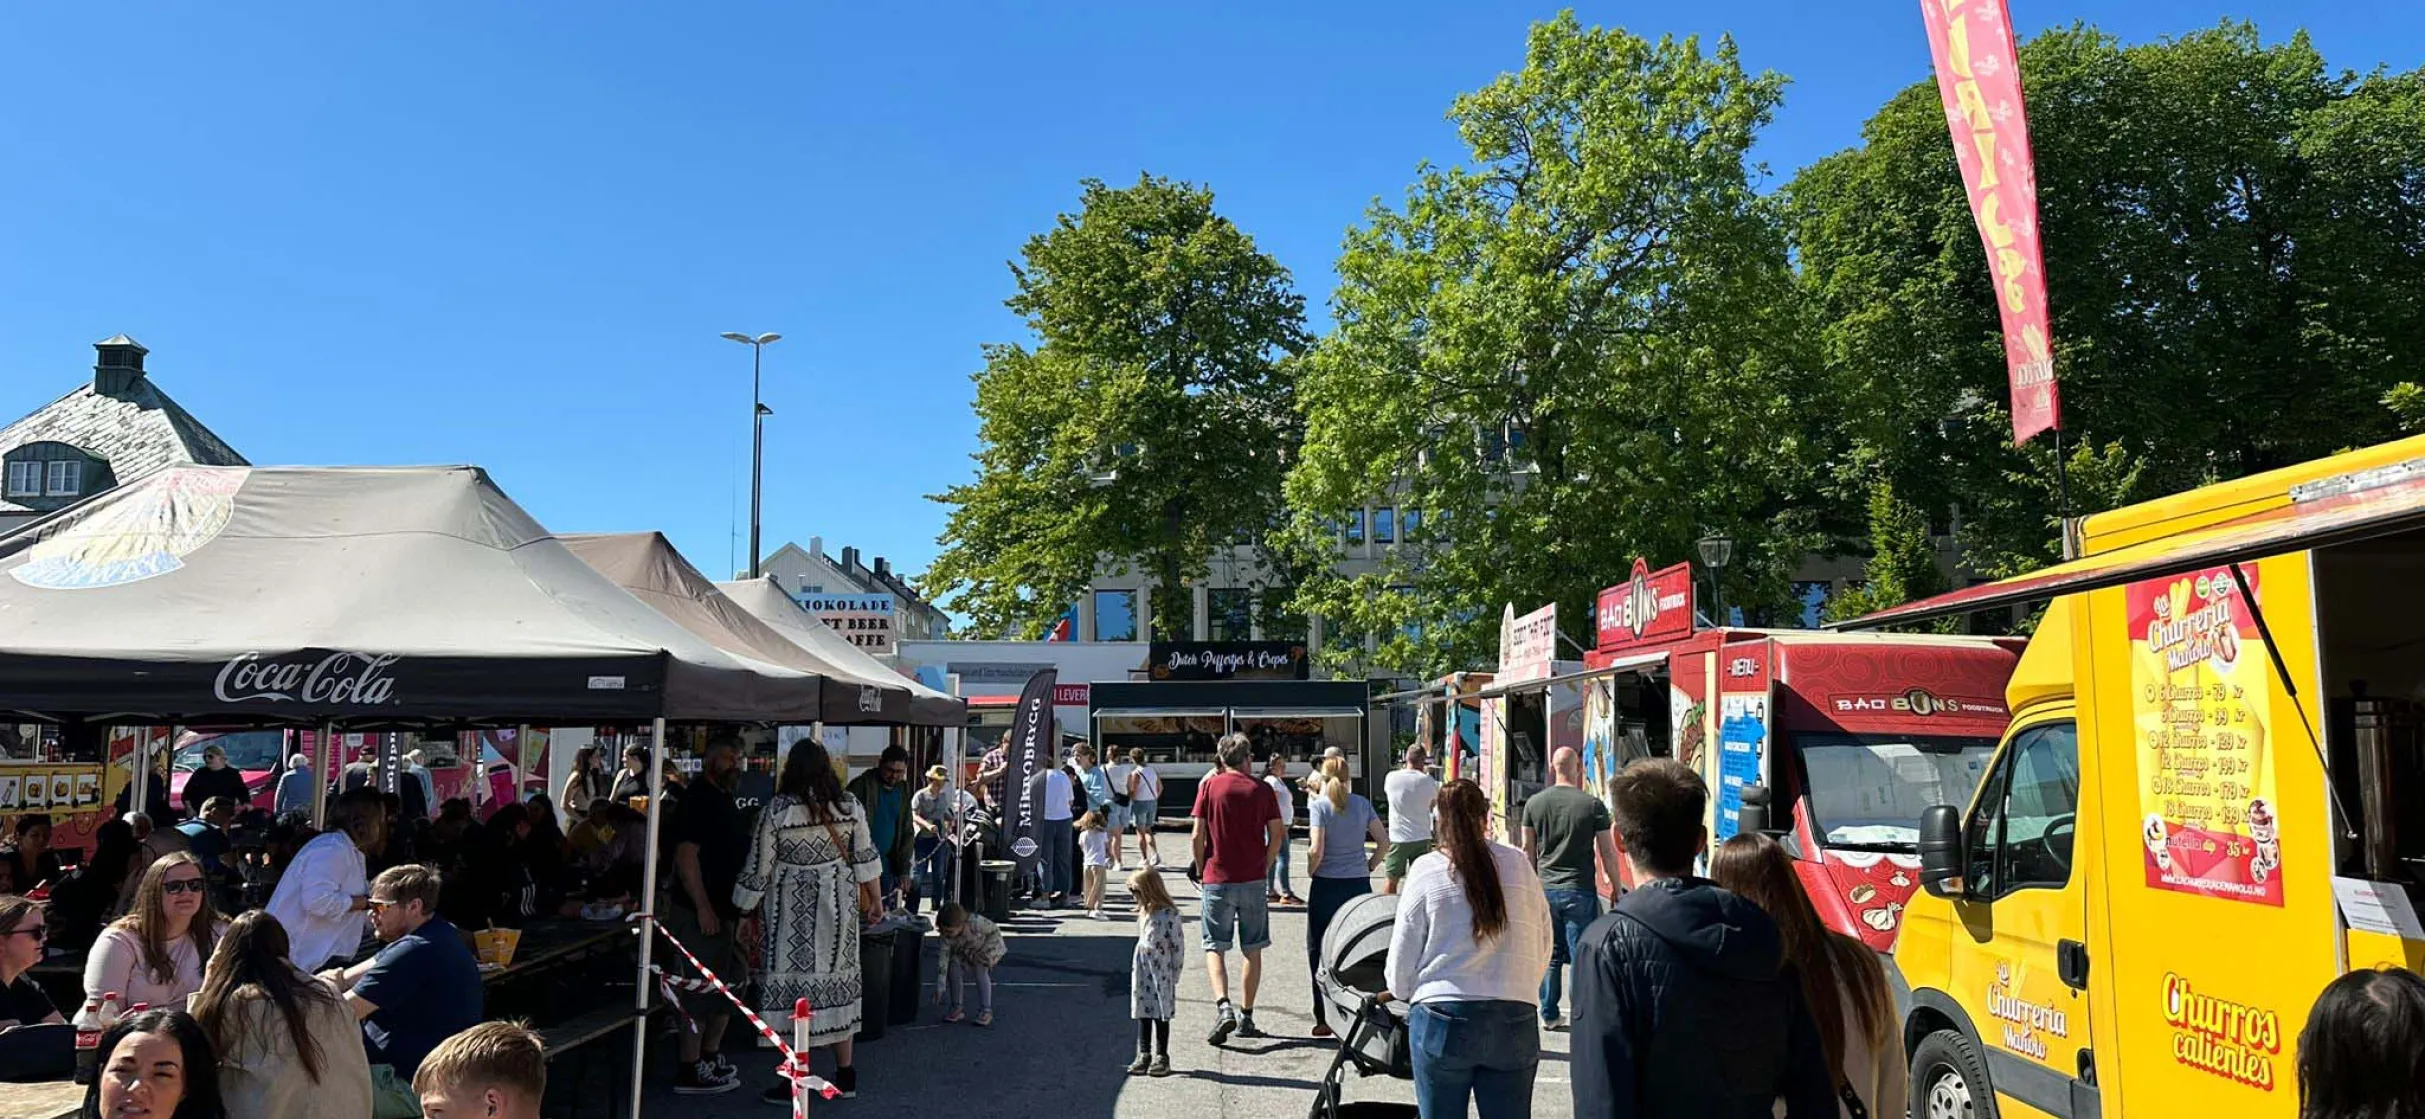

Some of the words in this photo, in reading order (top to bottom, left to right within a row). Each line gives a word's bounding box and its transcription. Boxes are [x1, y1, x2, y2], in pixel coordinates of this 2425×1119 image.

[797, 600, 890, 611] JOKOLADE
[848, 618, 889, 630] BEER
[2148, 597, 2232, 653] Churreria
[845, 634, 885, 646] AFFE
[1168, 651, 1198, 670] Dutch
[1247, 650, 1255, 667] &
[2167, 639, 2213, 673] Manolo
[214, 651, 399, 704] Coca-Cola
[2168, 684, 2204, 701] Churros
[1890, 690, 1959, 716] BUNS
[1961, 704, 2004, 713] FOODTRUCK
[2168, 706, 2205, 723] Churros
[2172, 731, 2208, 749] Churros
[2173, 752, 2209, 771] Churros
[2175, 777, 2211, 796] Churros
[2177, 800, 2214, 820] Churros
[2165, 833, 2201, 849] nutella
[2227, 840, 2240, 858] 35
[1987, 981, 2068, 1039] Churreria
[2161, 971, 2280, 1055] Churros
[2002, 1023, 2047, 1061] Manolo
[2172, 1031, 2274, 1091] calientes
